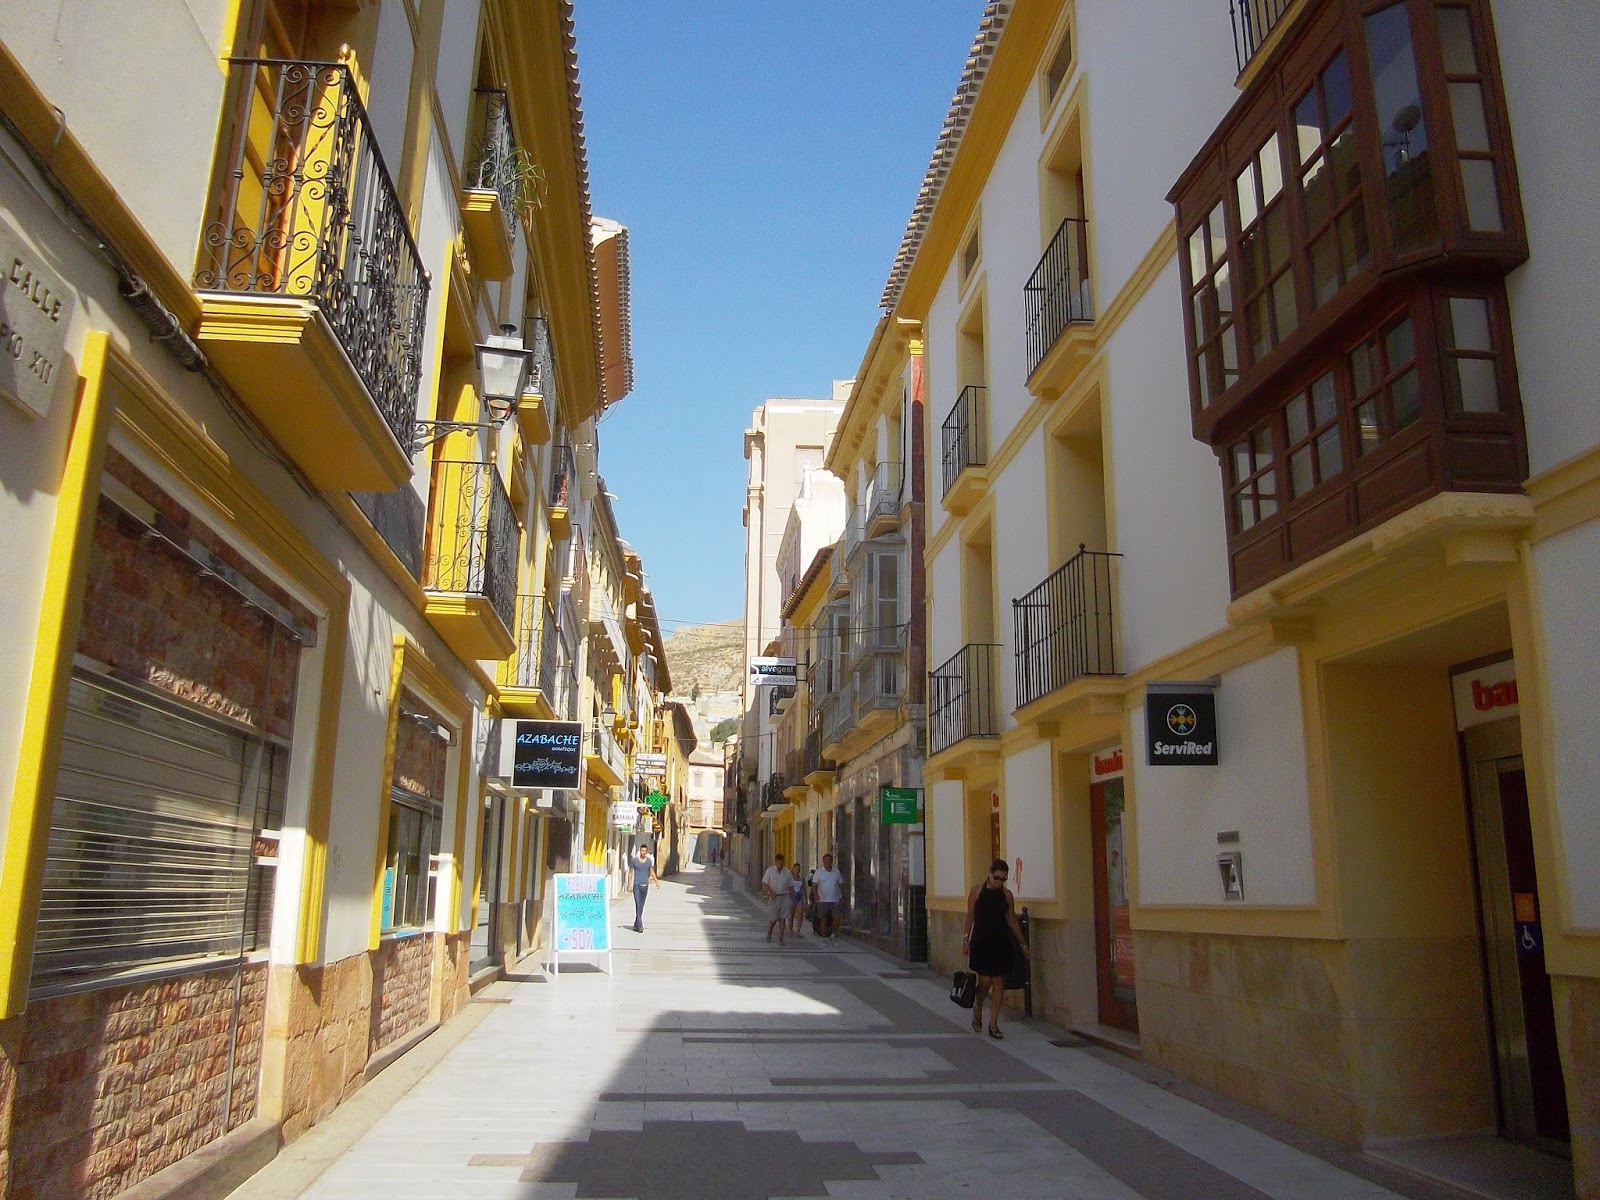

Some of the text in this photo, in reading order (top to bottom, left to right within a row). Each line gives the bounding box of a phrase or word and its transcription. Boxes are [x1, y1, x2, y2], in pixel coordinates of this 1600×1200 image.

[10, 257, 62, 324] CALLE
[29, 350, 53, 384] XII
[763, 676, 794, 684] ABOGADOS
[516, 733, 580, 745] AZABACHE
[1154, 740, 1212, 755] ServiRed
[568, 877, 596, 892] REBAJAS
